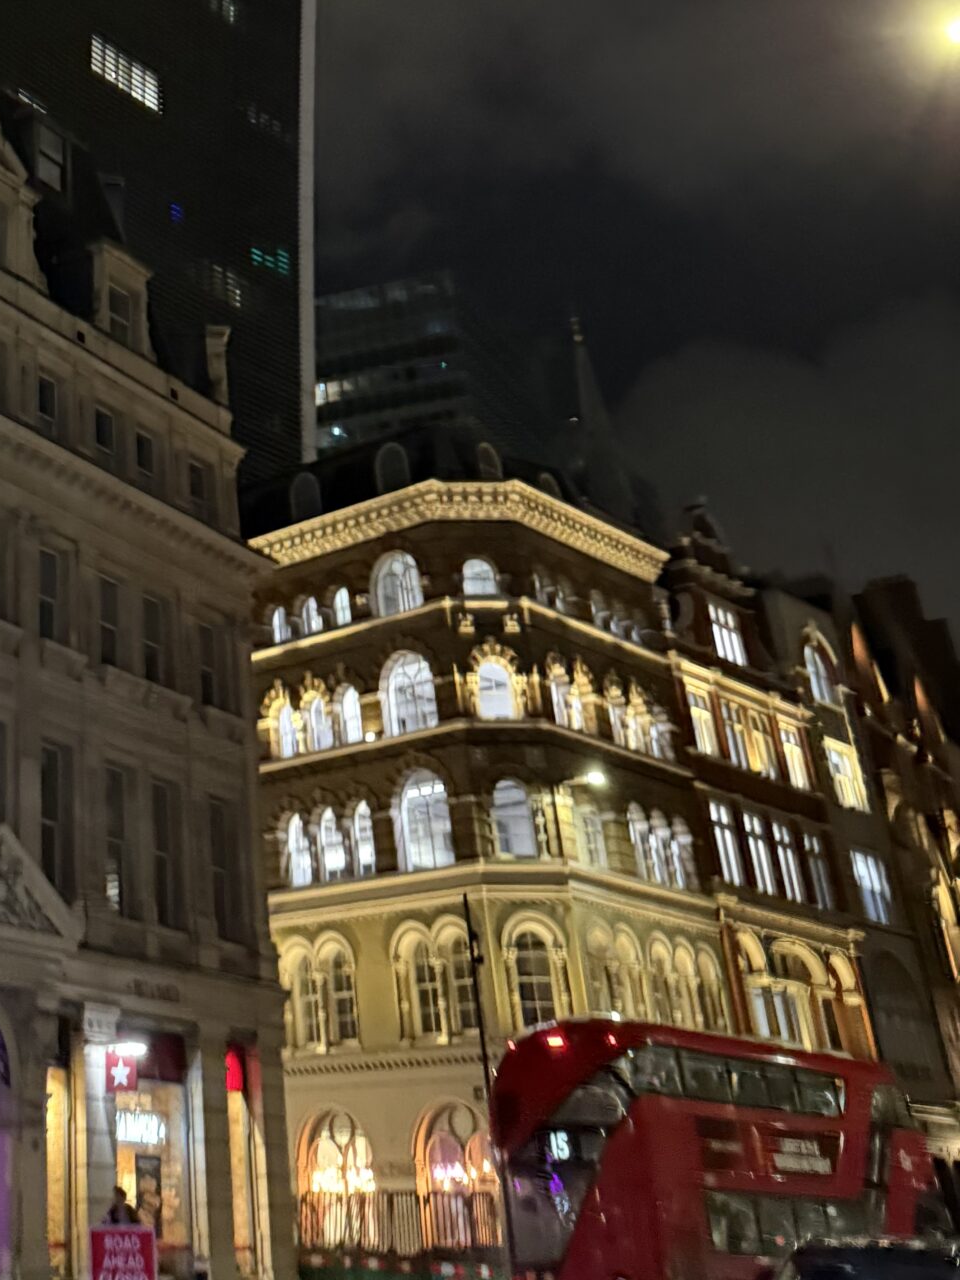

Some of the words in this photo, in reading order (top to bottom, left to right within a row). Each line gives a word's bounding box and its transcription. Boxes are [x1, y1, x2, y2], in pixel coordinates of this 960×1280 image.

[549, 1130, 570, 1161] 15
[103, 1233, 141, 1249] ROAD
[102, 1251, 145, 1269] AHEAD
